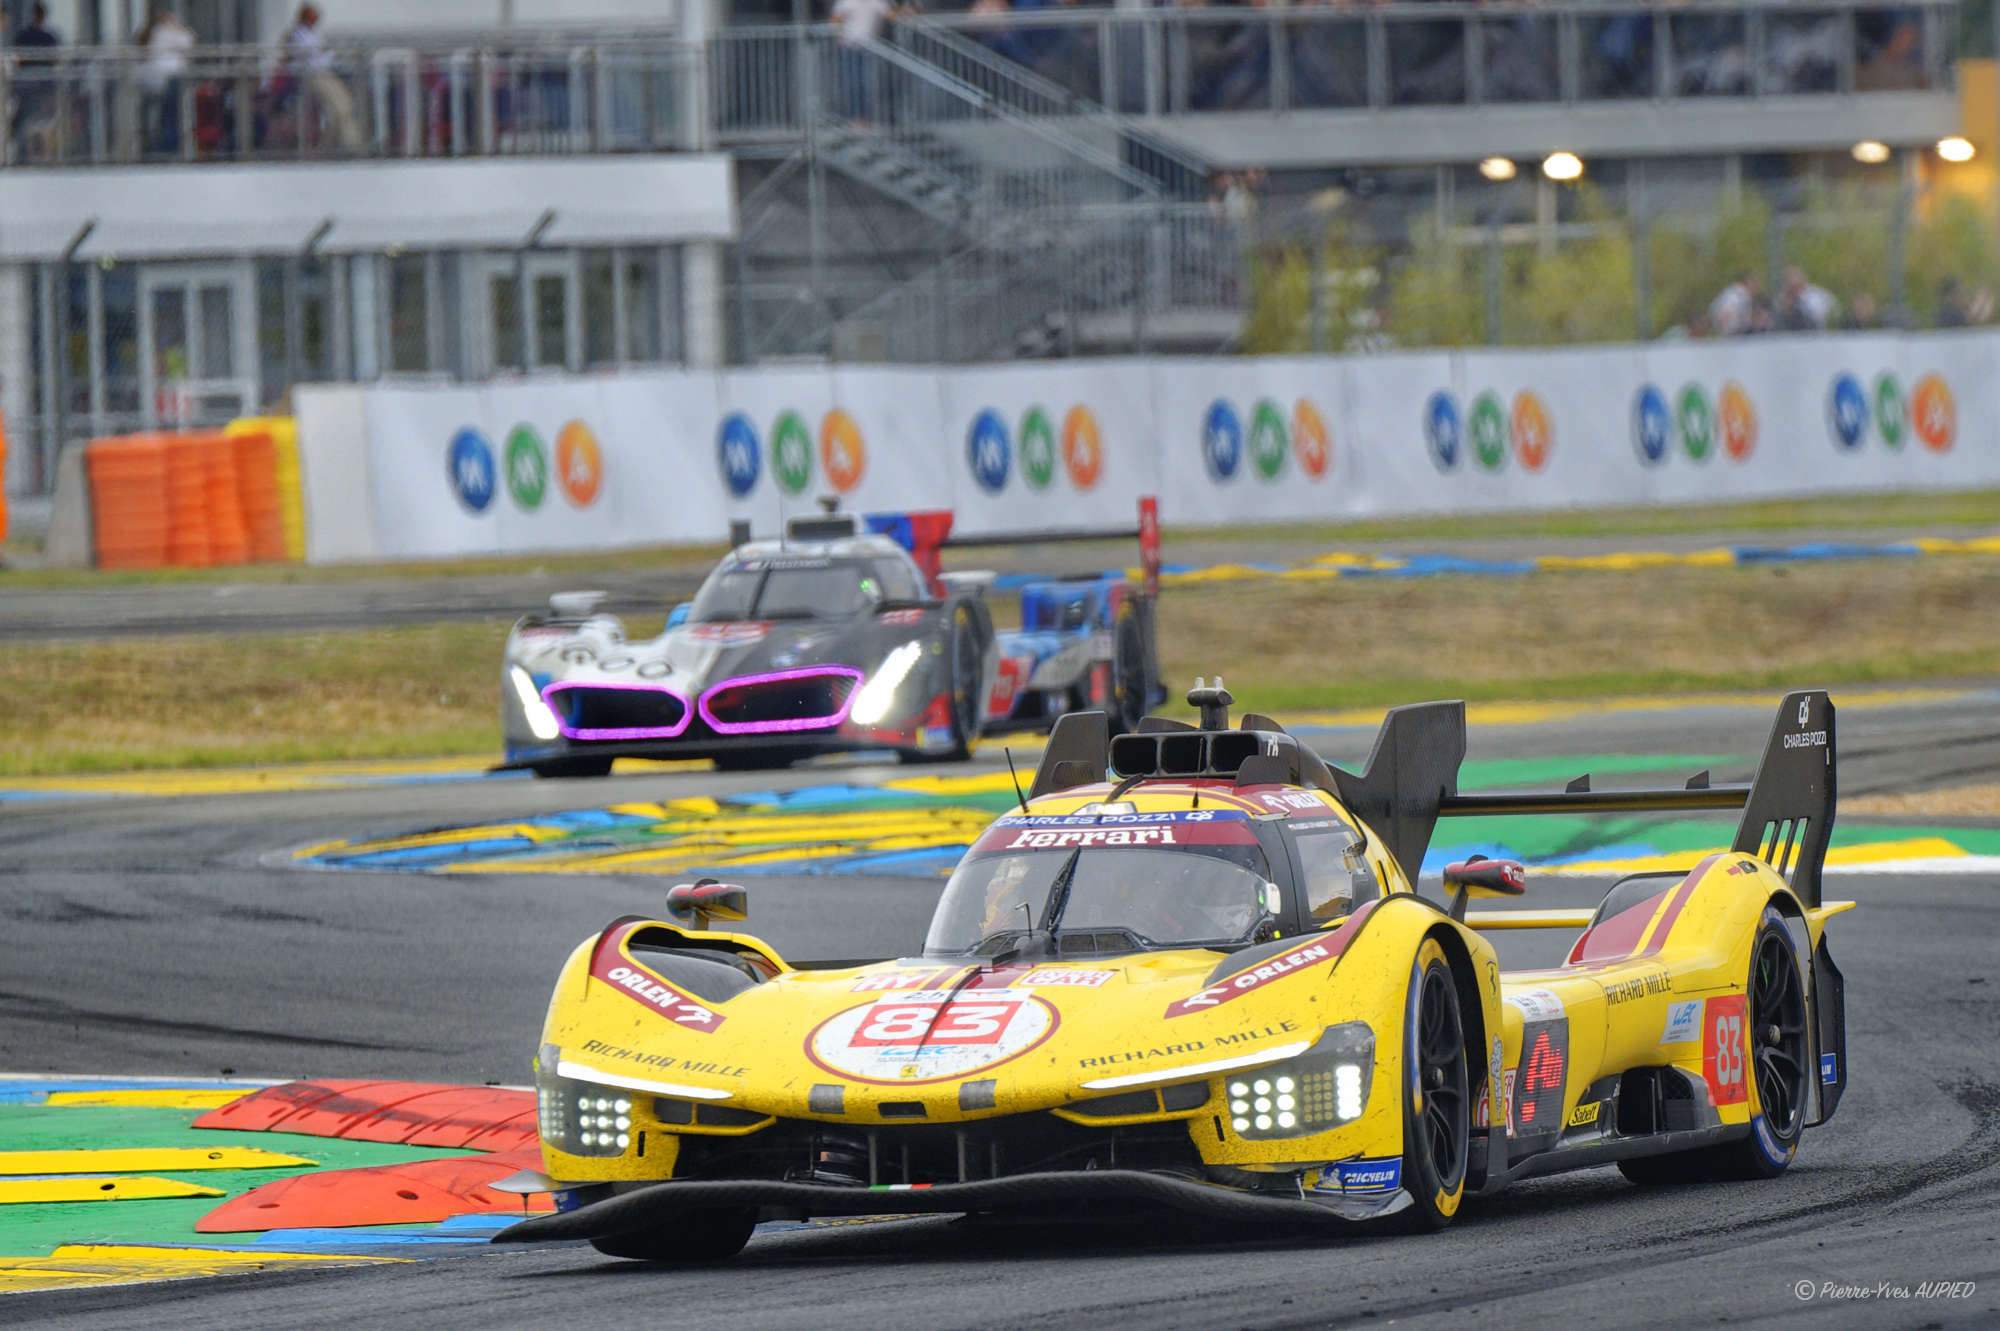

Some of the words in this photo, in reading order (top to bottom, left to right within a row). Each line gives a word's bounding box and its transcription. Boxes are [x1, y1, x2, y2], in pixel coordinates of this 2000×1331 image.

[1783, 732, 1809, 749] CHARLES
[1810, 731, 1827, 746] POZZI
[997, 816, 1096, 827] CHARLES
[1100, 812, 1176, 824] POZZI
[1006, 826, 1177, 849] Ferrari
[1026, 976, 1101, 985] CAR
[1234, 945, 1329, 989] ORLEN
[607, 967, 682, 1008] ORLEN
[1605, 978, 1645, 1007] RICHARD
[1645, 971, 1672, 995] MILLE
[863, 1005, 1009, 1041] 83
[581, 1039, 677, 1067] RICHARD
[679, 1060, 752, 1078] MILLE
[1079, 1040, 1205, 1069] RICHARD
[1214, 1018, 1301, 1047] MILLE
[1716, 1015, 1742, 1085] 83
[1572, 1104, 1597, 1124] Sabelt
[1343, 1170, 1396, 1184] MICHELIN
